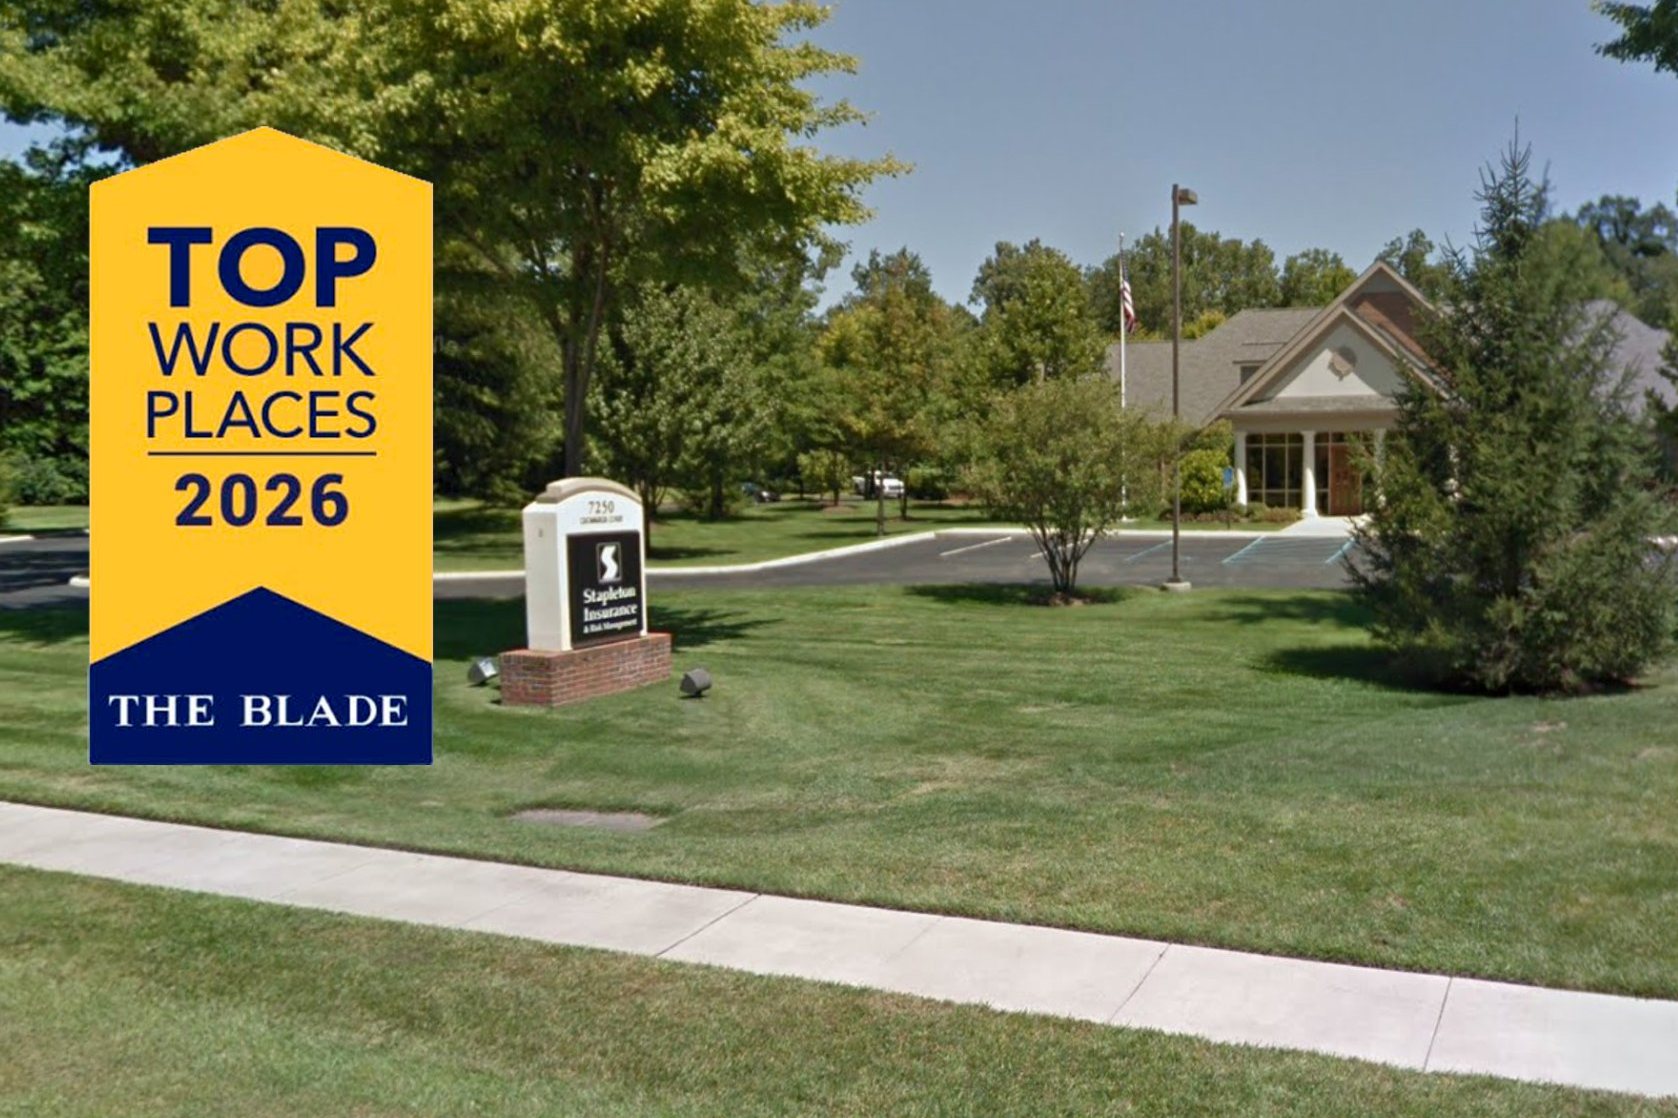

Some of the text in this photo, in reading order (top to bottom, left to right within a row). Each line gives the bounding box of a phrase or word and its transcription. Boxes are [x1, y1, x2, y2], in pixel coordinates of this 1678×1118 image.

[588, 500, 615, 514] 7250
[583, 586, 636, 606] Stapleton
[584, 604, 638, 622] Insurance
